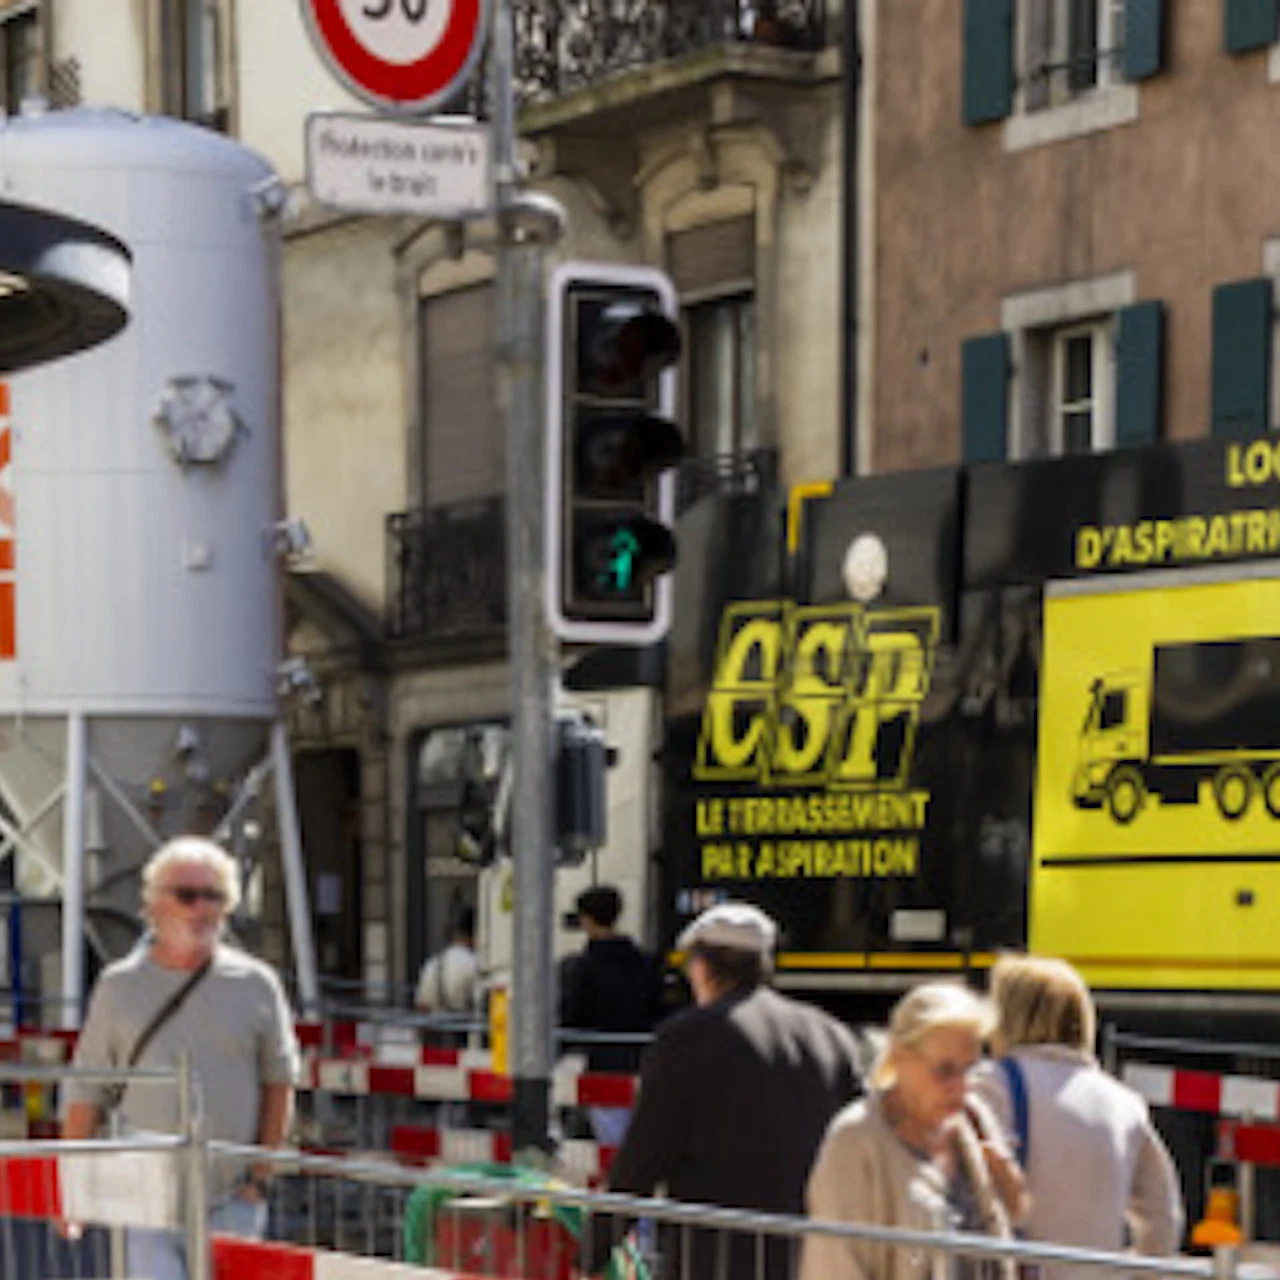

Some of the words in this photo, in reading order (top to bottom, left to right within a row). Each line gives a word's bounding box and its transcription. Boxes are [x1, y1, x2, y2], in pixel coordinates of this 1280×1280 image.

[696, 797, 724, 836] LE
[701, 842, 751, 881] PAR
[755, 836, 921, 878] ASPIRATION
